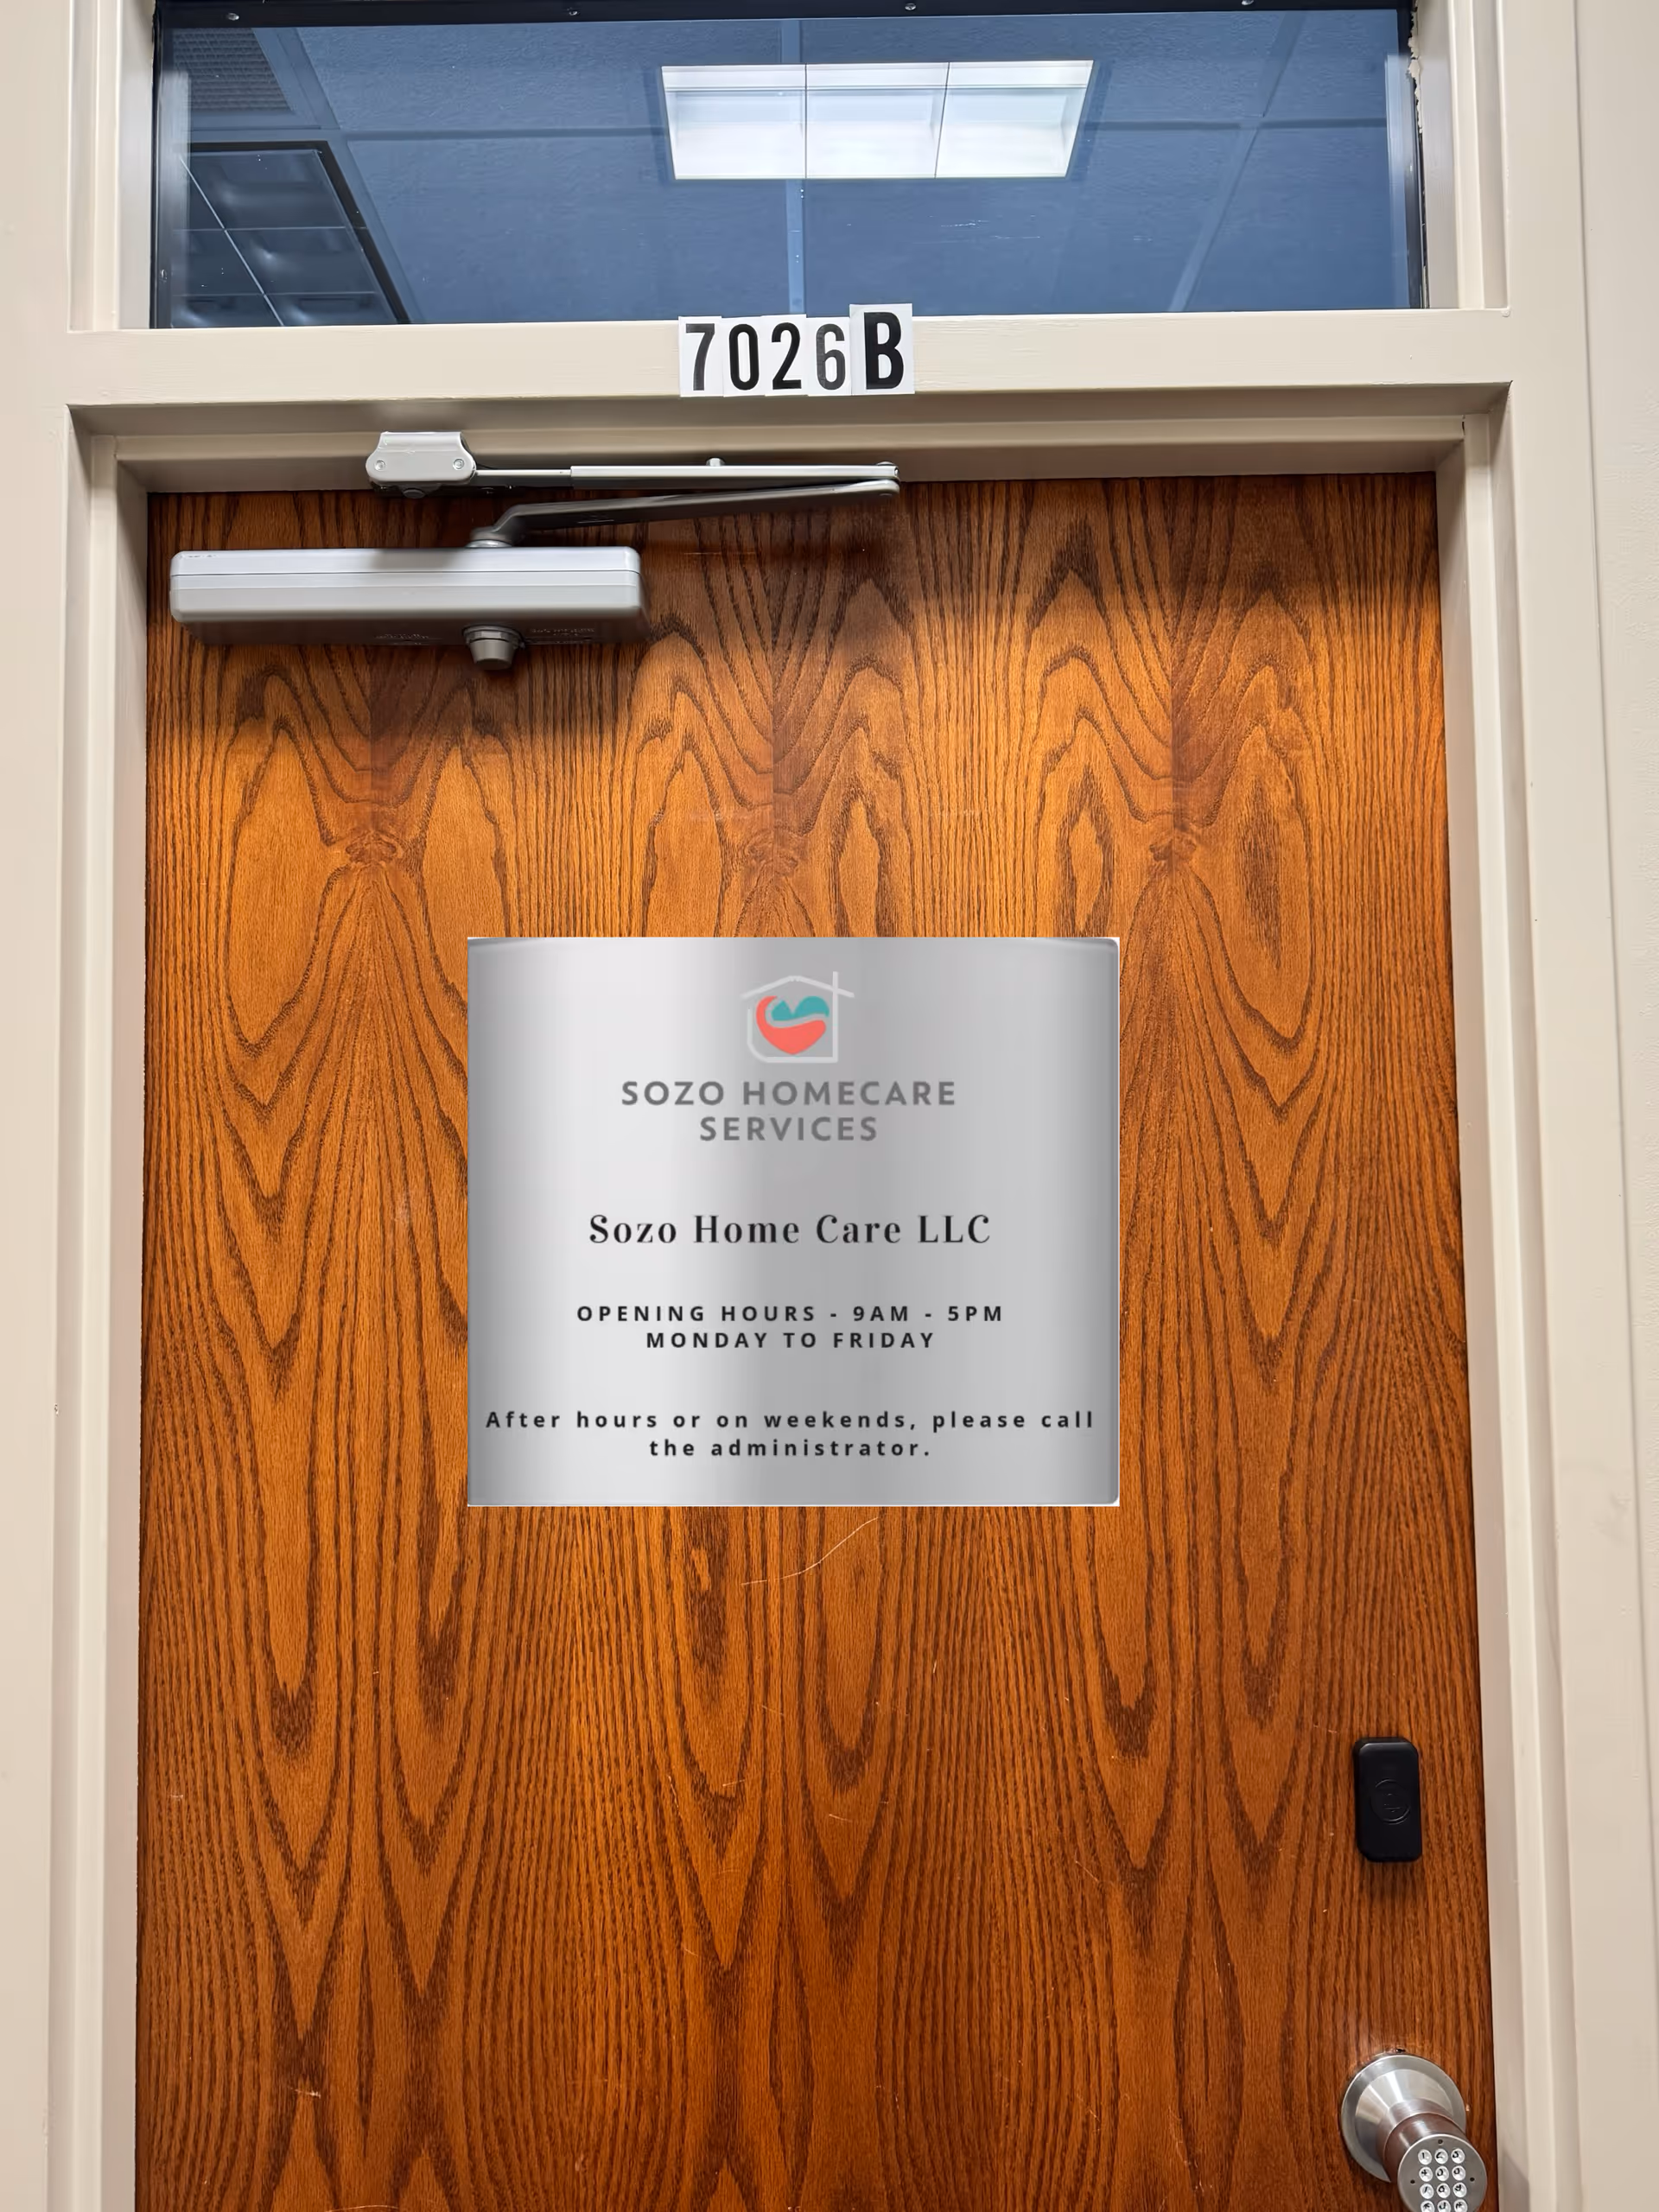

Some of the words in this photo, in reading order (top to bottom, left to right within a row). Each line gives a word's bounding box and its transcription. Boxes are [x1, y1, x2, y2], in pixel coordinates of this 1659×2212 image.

[621, 1080, 725, 1107] SOZO
[742, 1081, 955, 1106] HOMECARE
[699, 1116, 877, 1142] SERVICES
[588, 1213, 677, 1244] Sozo
[693, 1214, 800, 1244] Home
[816, 1214, 901, 1244] Care
[918, 1213, 991, 1244] LLC
[576, 1305, 705, 1323] OPENING
[721, 1305, 816, 1323] HOURS
[852, 1305, 909, 1323] 9AM
[947, 1305, 1002, 1323] 5PM
[645, 1332, 768, 1349] MONDAY
[782, 1332, 817, 1349] TO
[833, 1332, 934, 1349] FRIDAY
[485, 1410, 561, 1429] After
[576, 1409, 658, 1429] hours
[672, 1414, 701, 1429] or
[715, 1414, 748, 1429] on
[763, 1409, 918, 1432] weekends,
[932, 1410, 1026, 1434] please
[1040, 1410, 1094, 1429] call
[648, 1438, 696, 1458] the
[710, 1437, 931, 1458] administrator.
